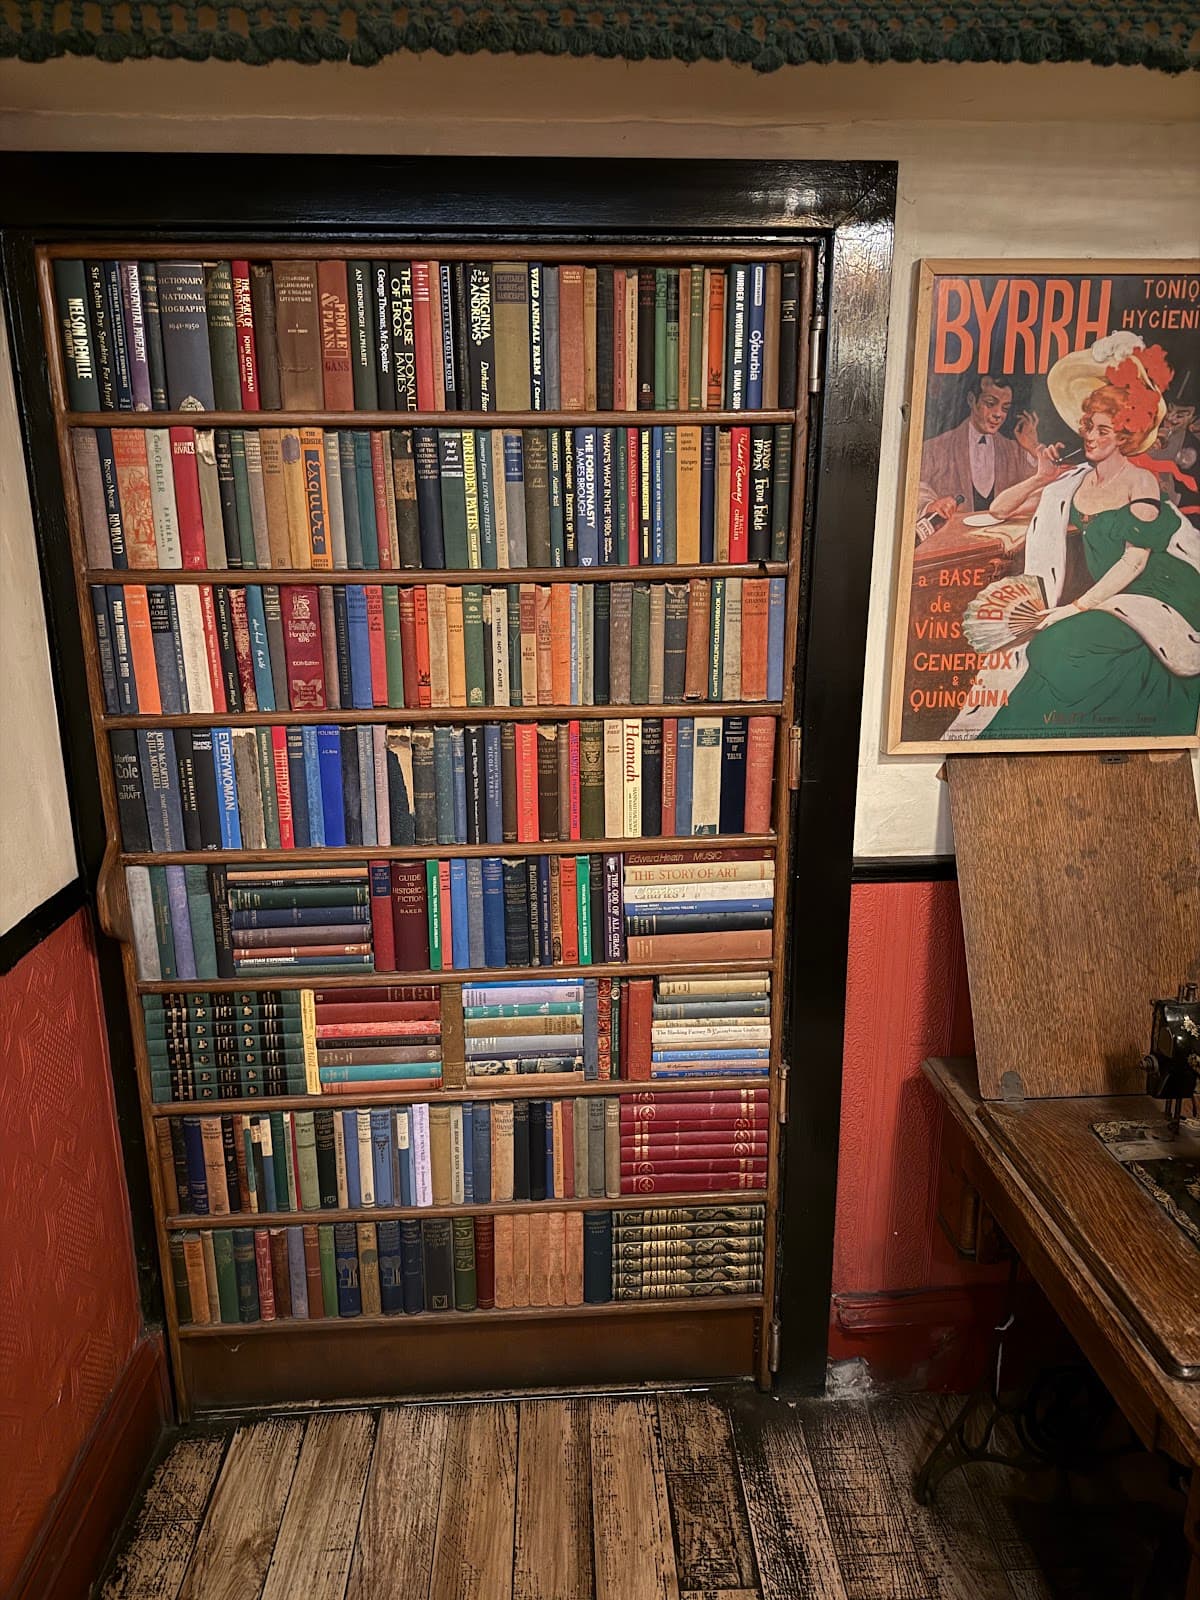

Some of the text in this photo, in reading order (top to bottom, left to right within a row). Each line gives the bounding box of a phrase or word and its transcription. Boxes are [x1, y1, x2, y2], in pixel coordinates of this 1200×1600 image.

[91, 266, 100, 279] Sir
[376, 268, 386, 297] George
[400, 268, 412, 296] THE
[530, 267, 540, 298] WILD
[93, 282, 102, 309] Robin
[390, 278, 402, 336] OF EROS
[96, 312, 106, 328] Day
[128, 265, 146, 363] INSUBSTANTIAL PAGEANT
[320, 292, 340, 348] & PLANS
[334, 303, 348, 348] PEOPLE
[354, 268, 368, 367] AN EDINBURGH ALPHABET
[402, 299, 414, 346] HOUSE
[470, 284, 482, 340] ANDREWS
[480, 284, 491, 340] VIRGINIA
[531, 300, 541, 344] ANIMAL
[934, 279, 1112, 374] BYRRH
[64, 329, 75, 359] COUNTRY
[68, 298, 92, 380] NELSON DEMILLE
[381, 330, 389, 342] Mr
[733, 270, 745, 392] MURDER AT WROTHAM HILL DIANA
[98, 331, 109, 364] Speaking
[380, 344, 390, 373] Speaker
[532, 344, 542, 376] FARM
[749, 330, 764, 381] Cyburbia
[102, 367, 111, 380] For
[244, 336, 255, 392] JOHN GOTTMAN
[325, 360, 350, 372] GANS
[394, 352, 406, 393] JAMES
[104, 382, 114, 408] Myself
[480, 361, 490, 412] Darkest Hour
[565, 430, 573, 454] Isabel
[602, 432, 611, 464] WHAT'S
[462, 432, 479, 530] FORBIDDEN PATHS
[576, 447, 586, 516] JAMES BROUGH
[584, 434, 596, 528] THE FORD DYNASTY
[604, 463, 612, 489] WHAT
[604, 488, 611, 497] IN
[754, 478, 770, 531] Fame Fatale
[604, 516, 612, 537] 1980s
[938, 568, 986, 587] BASE
[930, 595, 951, 613] de
[976, 583, 1031, 622] BYRRH
[915, 617, 961, 640] VINS
[913, 652, 1013, 672] GENEREUX
[952, 676, 984, 686] & de
[910, 686, 1010, 712] QUINQUINA
[145, 738, 158, 754] JILL
[274, 749, 288, 766] THE
[522, 728, 533, 760] PAUL
[626, 724, 640, 784] Hannah
[116, 764, 138, 779] Cole
[150, 754, 161, 790] MORRELL
[153, 732, 170, 790] JOHN McCARTHY
[218, 732, 236, 810] EVERYWOMAN
[119, 792, 141, 800] GRAFT
[122, 784, 135, 792] THE
[275, 766, 290, 798] HAPPY
[628, 852, 722, 864] Edward Heath MUSIC
[398, 874, 422, 882] GUIDE
[632, 868, 739, 880] THE STORY OF ART
[397, 894, 424, 903] FICTION
[634, 887, 684, 900] Charles
[612, 906, 619, 916] OF
[612, 918, 620, 932] ALL
[214, 912, 222, 944] WIVES
[218, 904, 230, 950] Establishment
